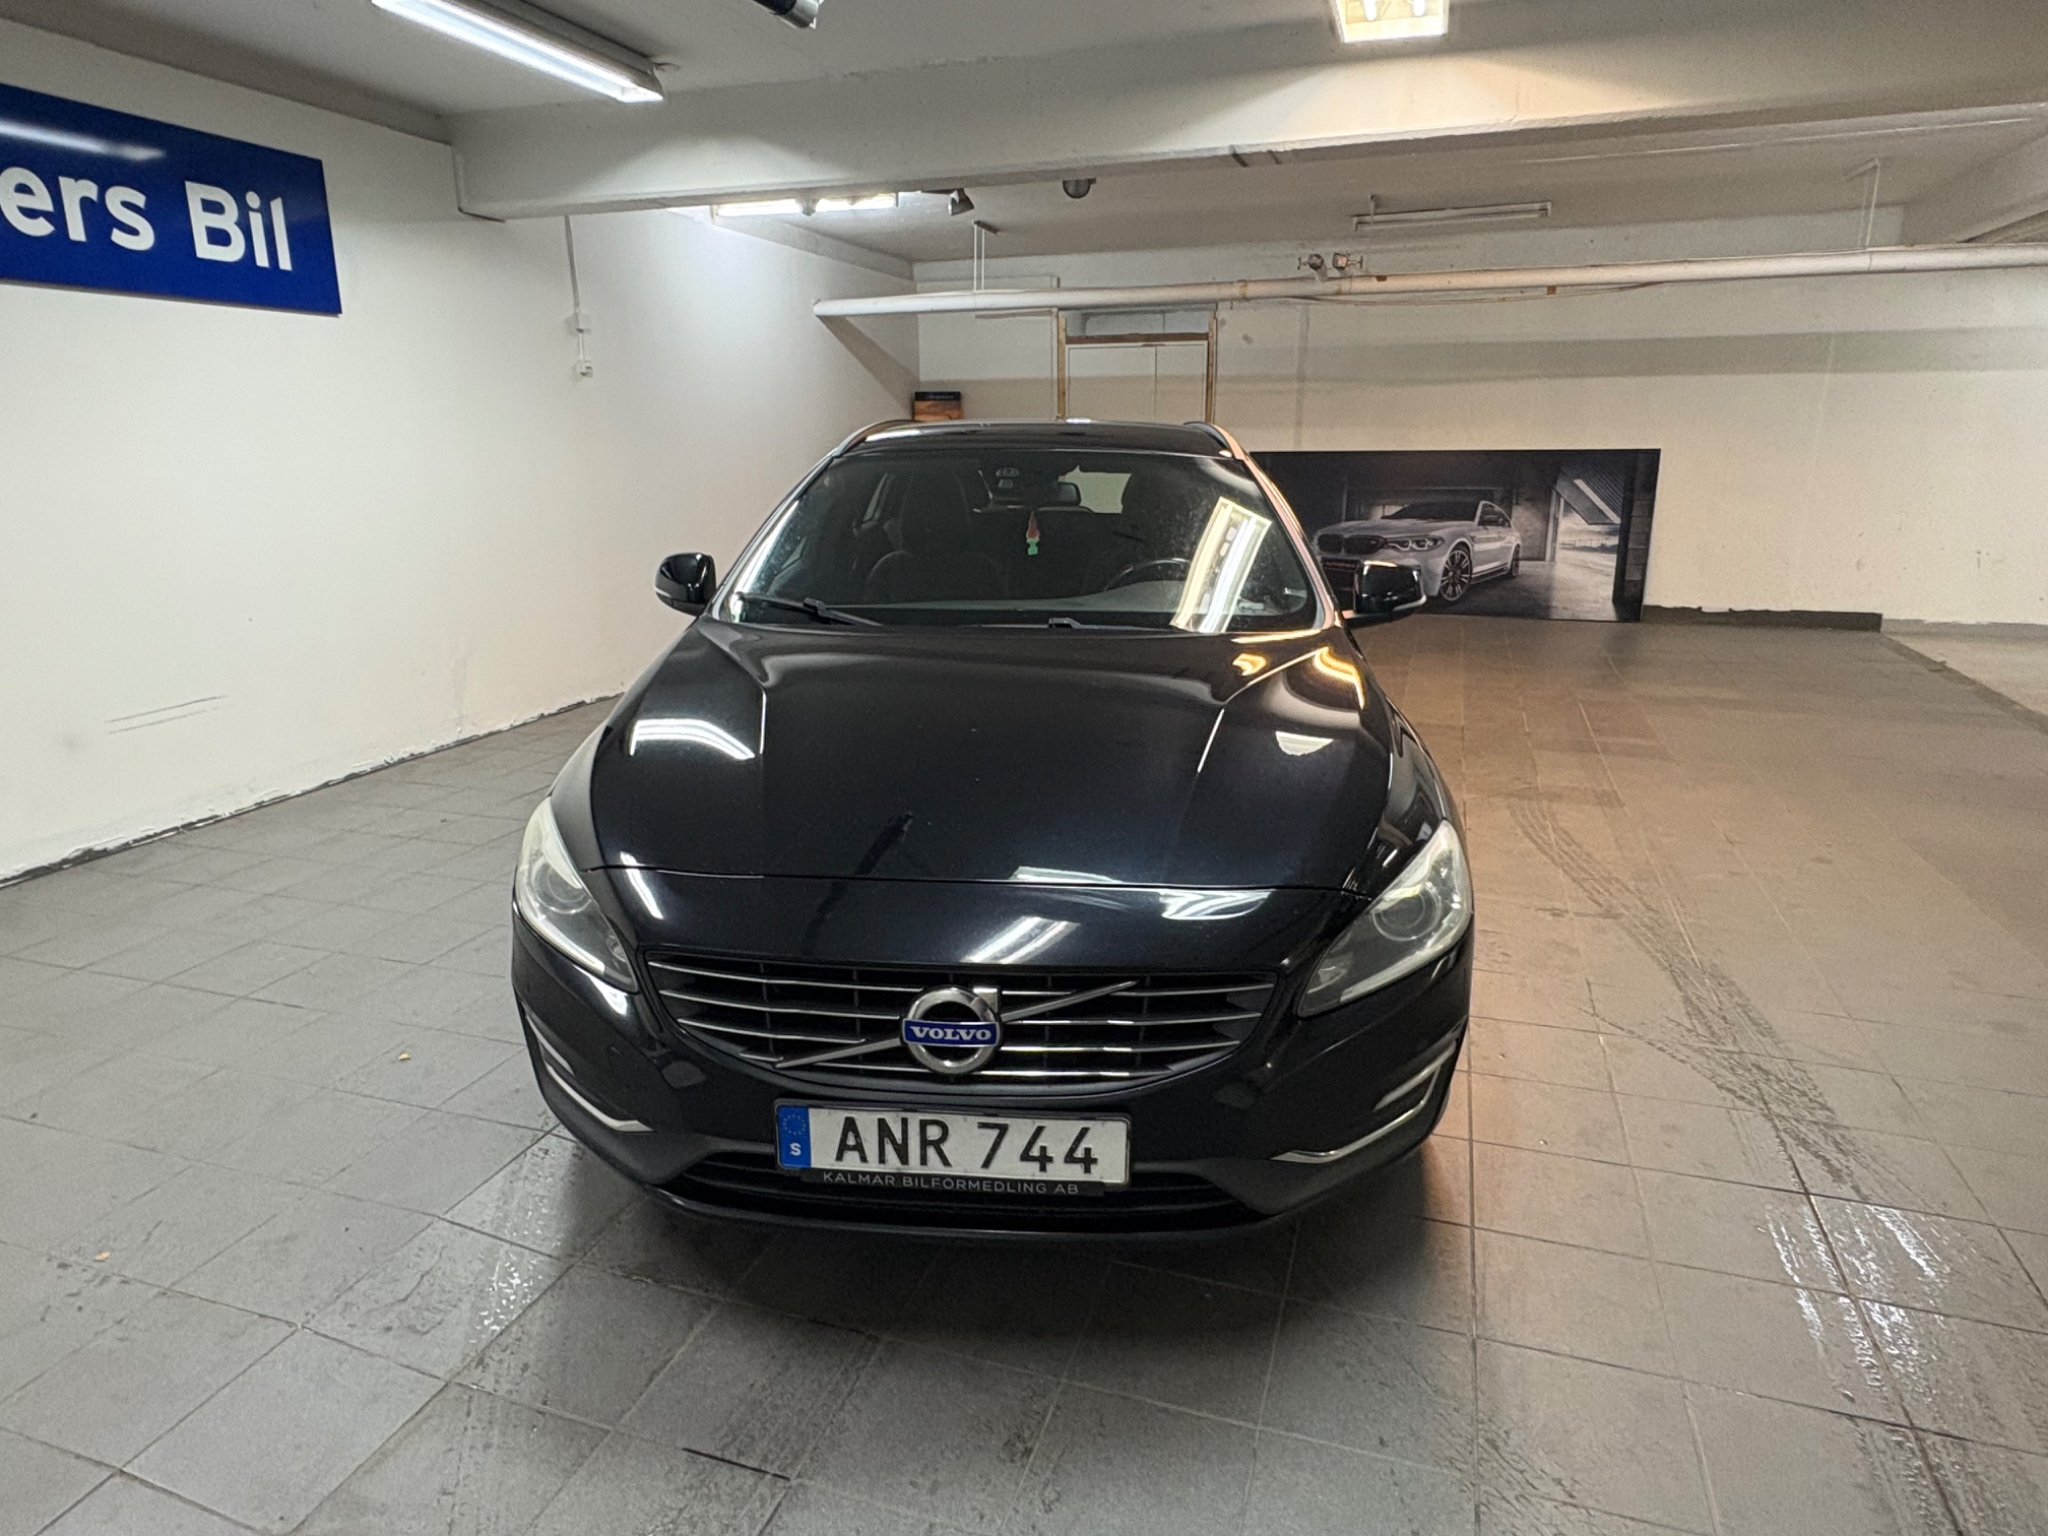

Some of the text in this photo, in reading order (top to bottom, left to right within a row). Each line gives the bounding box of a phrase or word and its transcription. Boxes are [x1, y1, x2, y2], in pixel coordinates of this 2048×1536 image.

[184, 180, 293, 271] Bil
[910, 1025, 993, 1041] VOLVO
[789, 1142, 802, 1156] S
[835, 1116, 1098, 1175] ANR 744
[823, 1171, 896, 1187] KALMAR
[1054, 1183, 1080, 1195] AB
